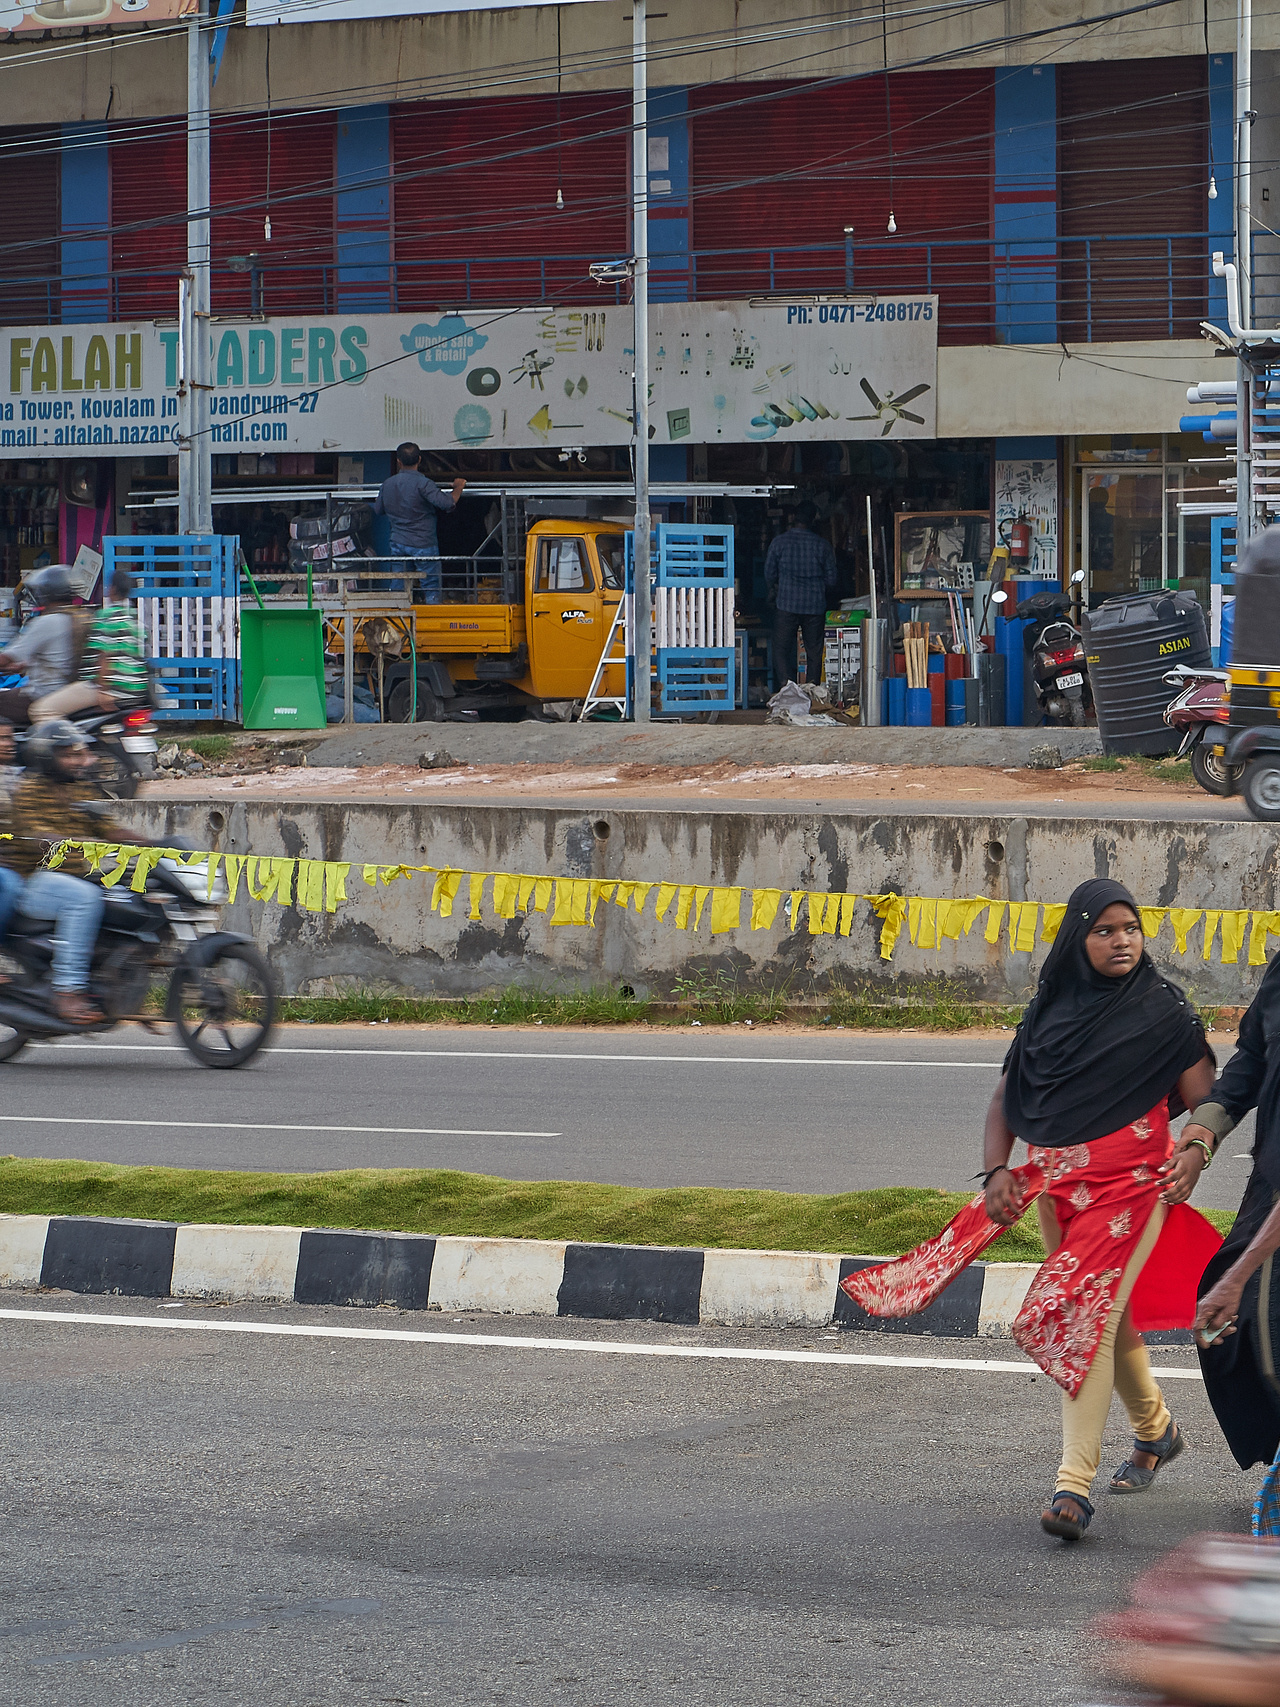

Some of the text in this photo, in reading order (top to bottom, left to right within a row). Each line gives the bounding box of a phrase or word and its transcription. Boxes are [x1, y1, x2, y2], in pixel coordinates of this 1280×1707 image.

[787, 301, 934, 325] Ph: 0471-2488175
[10, 325, 369, 393] FALAH TADERS
[435, 349, 466, 361] Retail
[20, 400, 75, 421] Tower,
[82, 397, 155, 419] Kovalam
[210, 392, 319, 415] vandrum-27
[0, 426, 37, 447] mail
[1159, 636, 1191, 656] ASIAN
